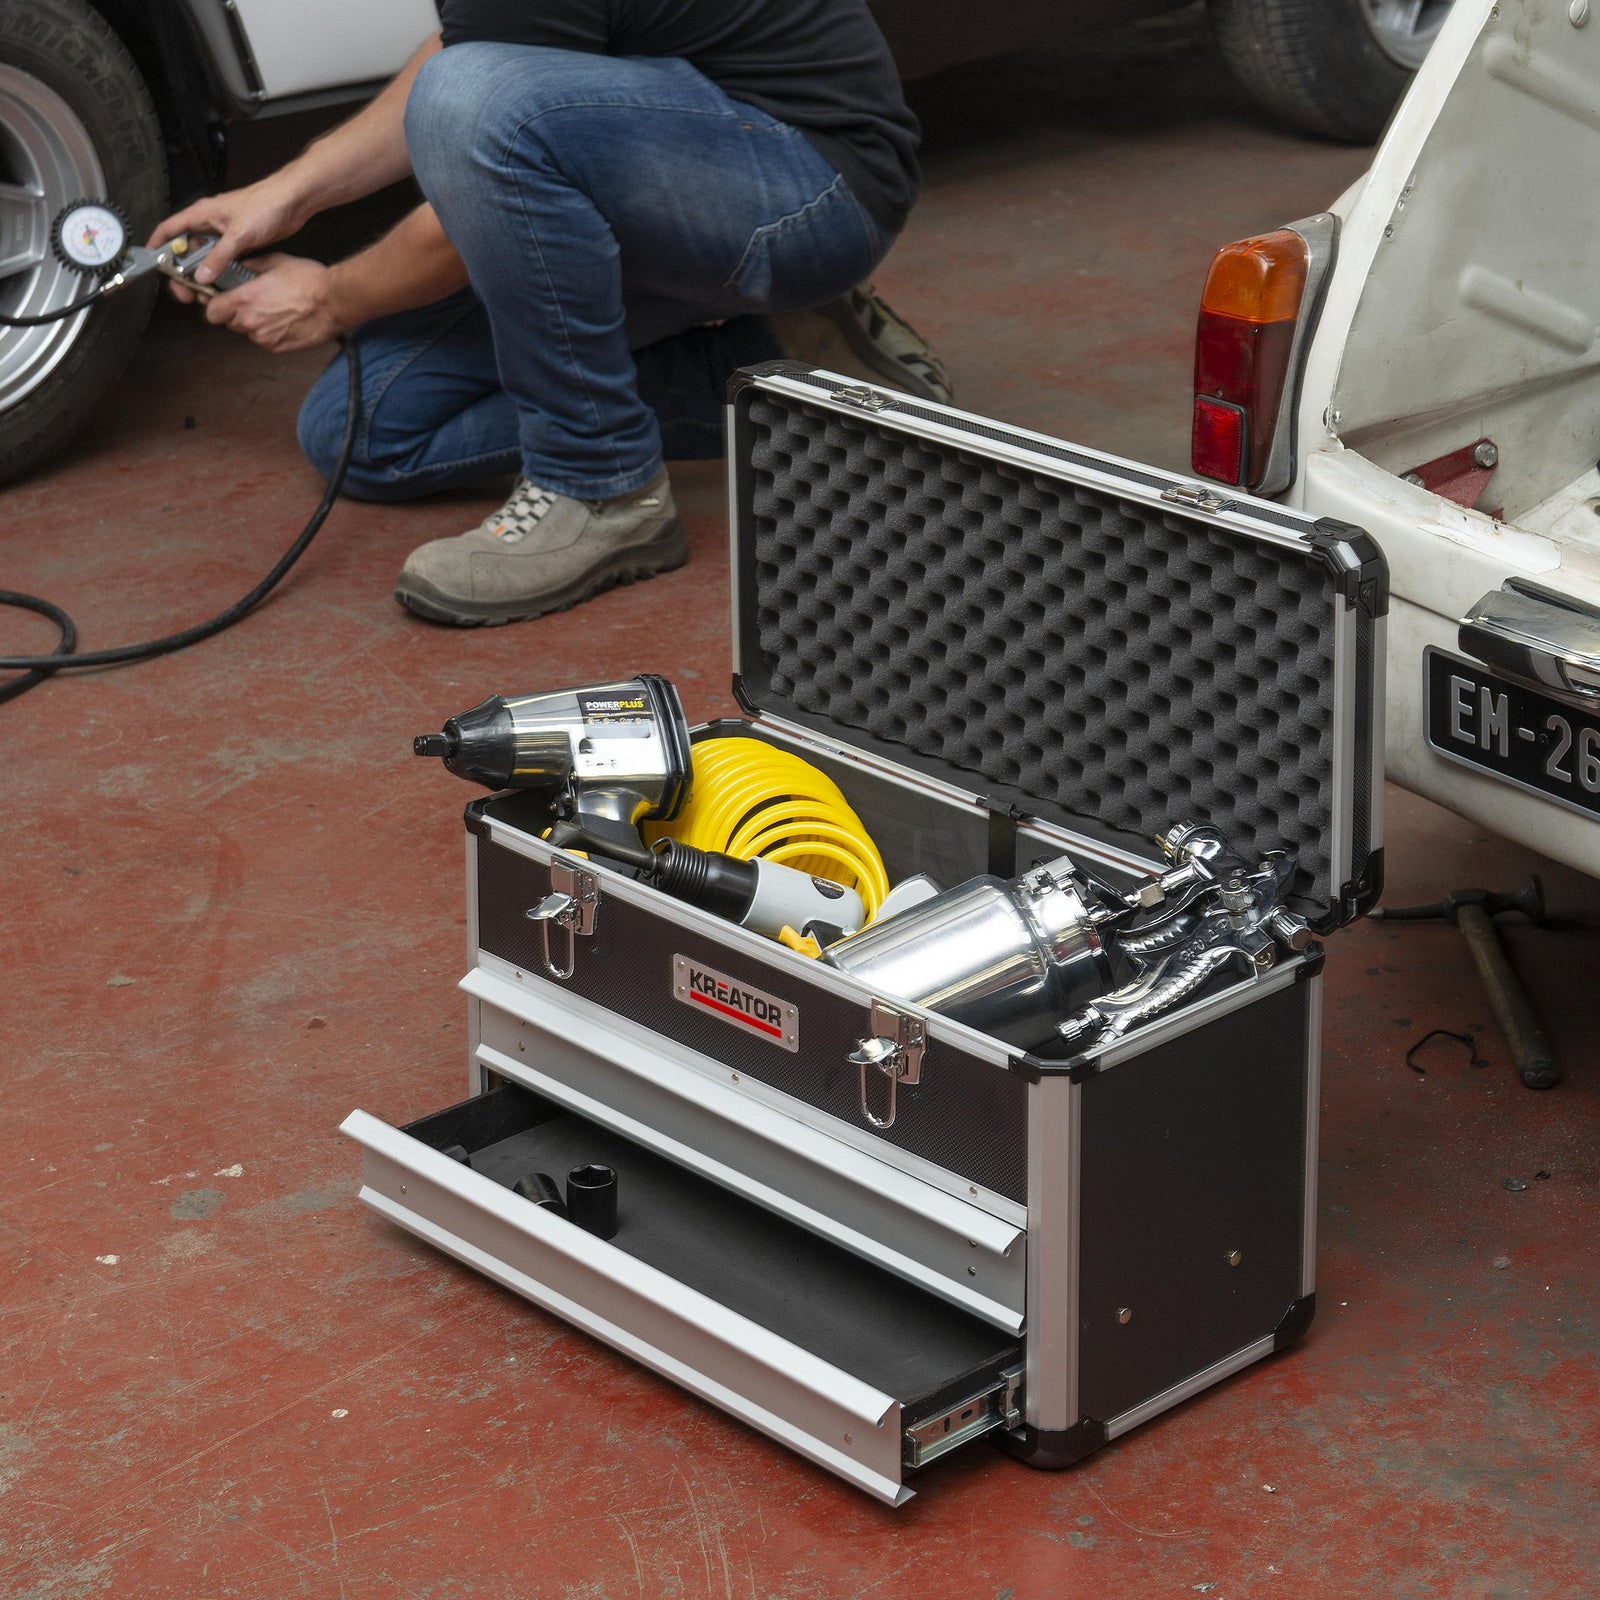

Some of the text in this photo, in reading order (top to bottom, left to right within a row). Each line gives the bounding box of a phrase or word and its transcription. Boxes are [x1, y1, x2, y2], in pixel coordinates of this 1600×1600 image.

[586, 700, 644, 708] POWERPLUS
[1451, 674, 1600, 793] EM-26
[690, 967, 782, 1028] KREATOR
